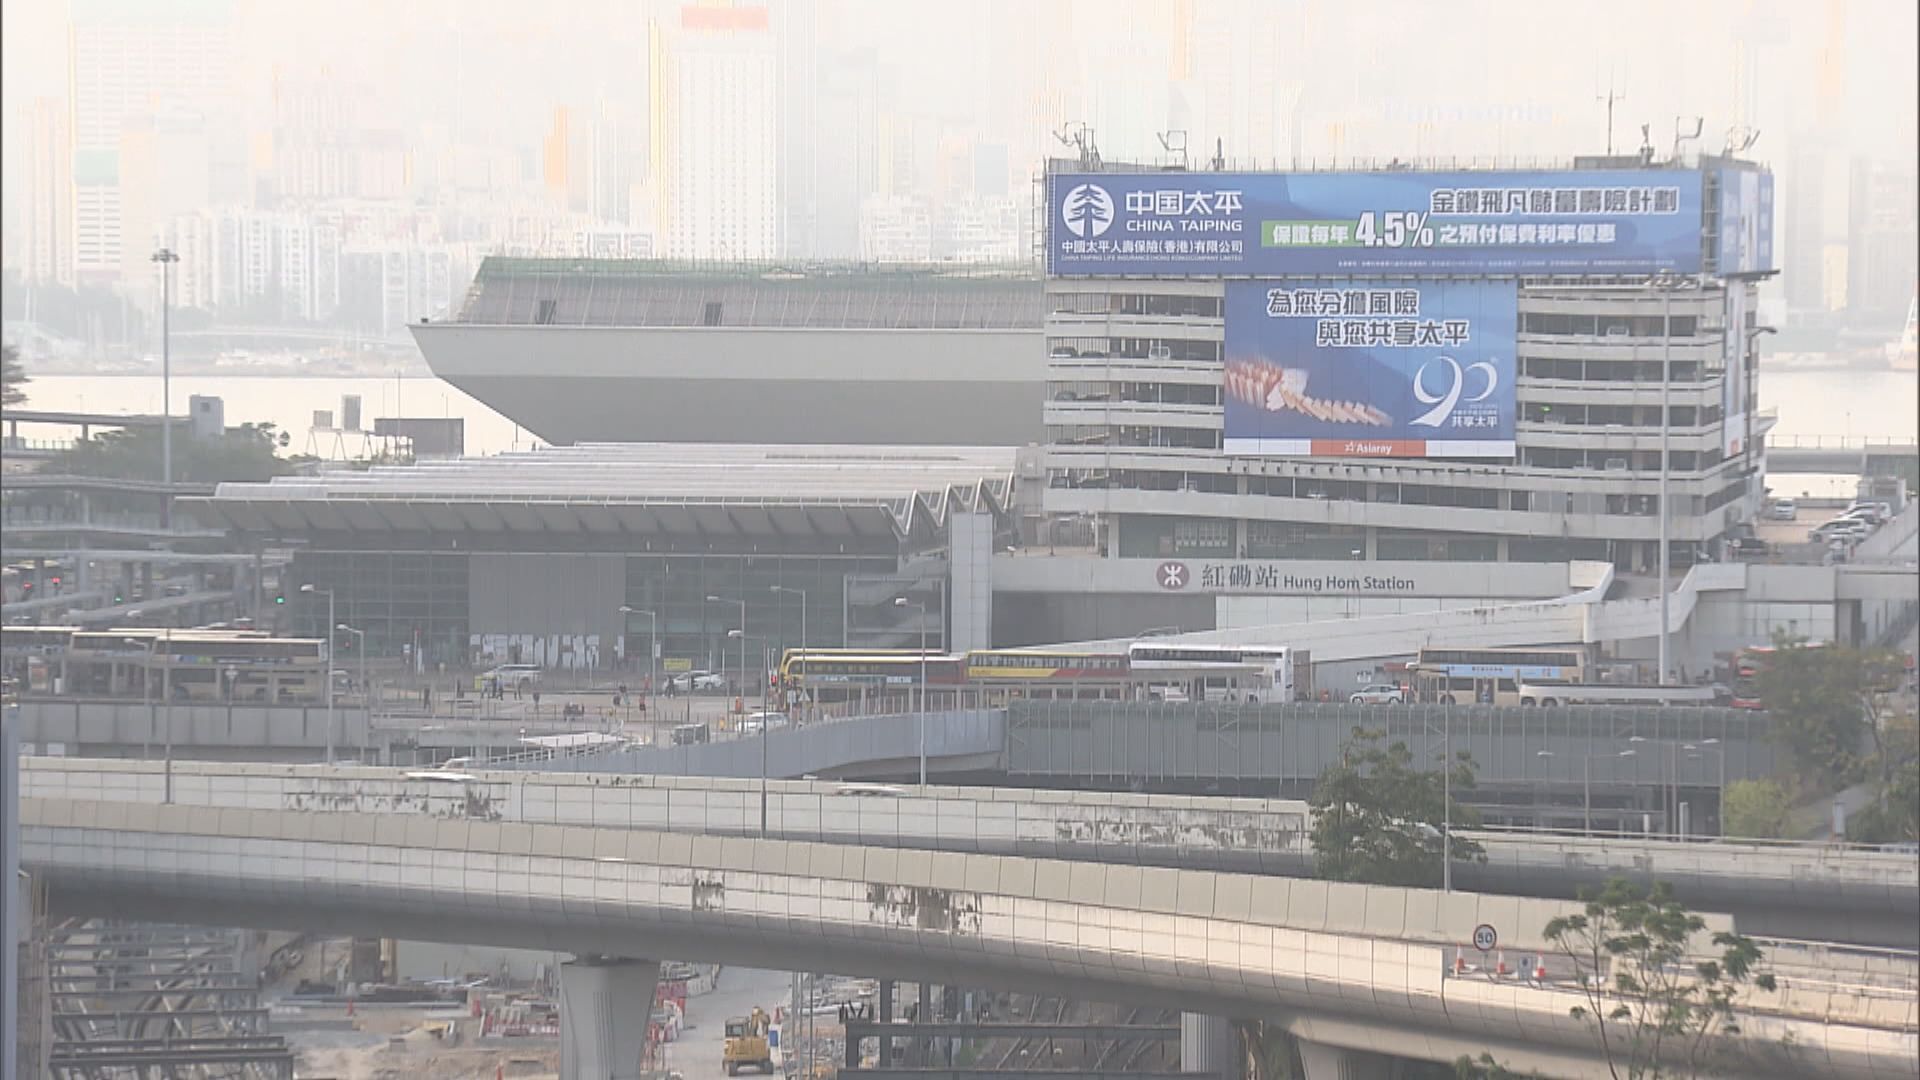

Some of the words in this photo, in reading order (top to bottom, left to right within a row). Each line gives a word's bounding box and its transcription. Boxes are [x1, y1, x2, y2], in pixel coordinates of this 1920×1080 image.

[1126, 190, 1242, 215] 中国太平
[1126, 220, 1174, 232] CHINA
[1180, 220, 1242, 232] TAIPING
[1355, 211, 1434, 248] 4.5%
[1267, 288, 1420, 317] 為您分擔風險
[1317, 319, 1469, 347] 與您共享太平
[1452, 416, 1498, 428] 共享太平
[1356, 442, 1393, 455] Asiaray
[1202, 564, 1279, 588] 紅磡站
[1284, 575, 1321, 591] Hung
[1326, 575, 1360, 590] Hom
[1364, 575, 1415, 590] Station
[1477, 932, 1493, 943] 50
